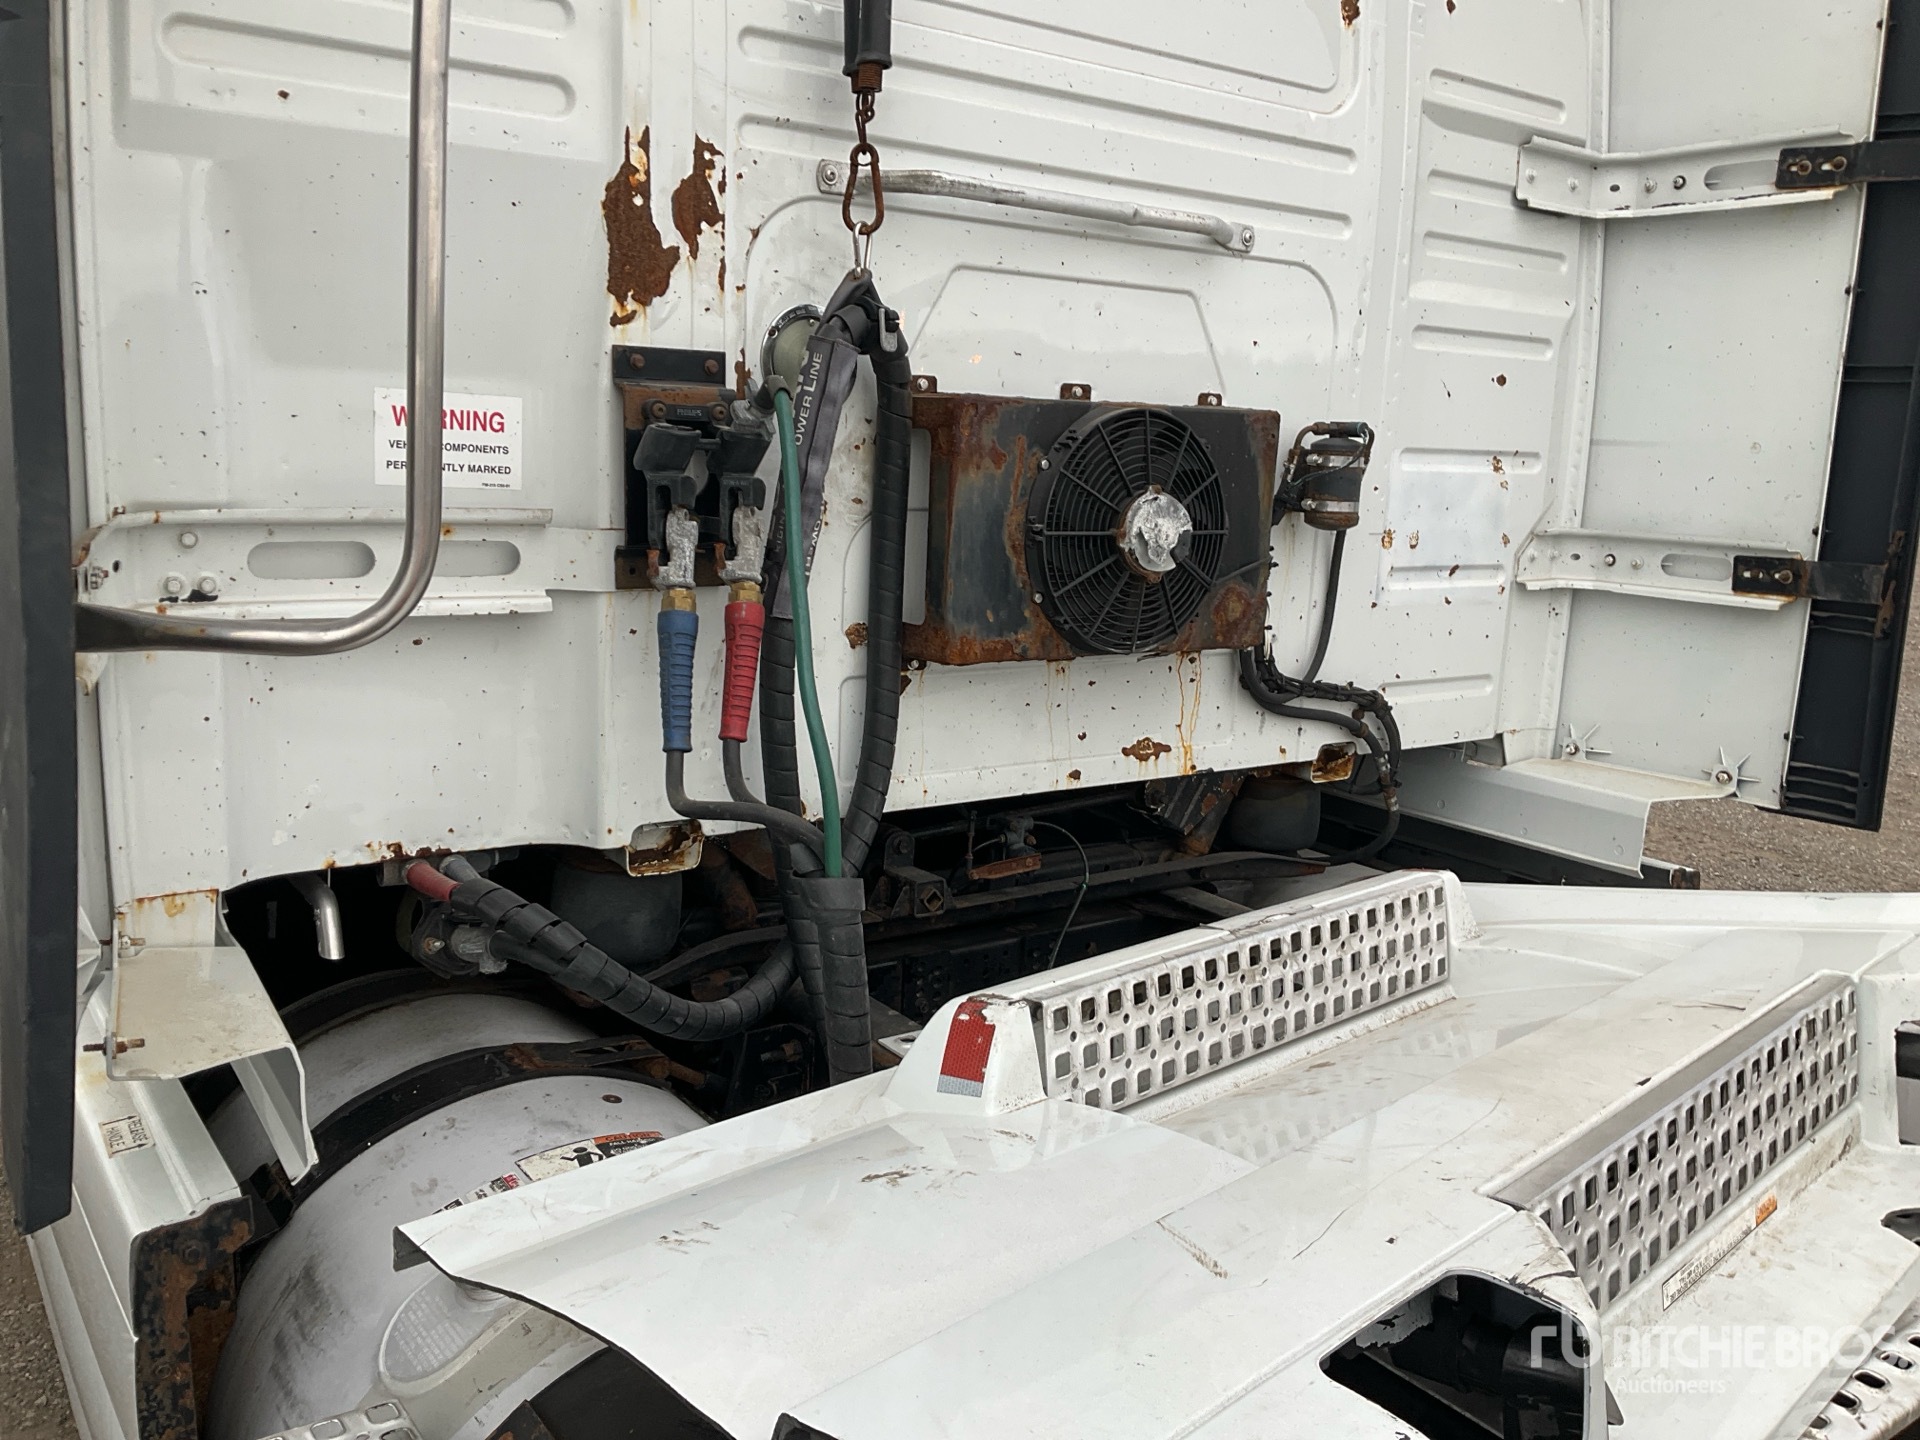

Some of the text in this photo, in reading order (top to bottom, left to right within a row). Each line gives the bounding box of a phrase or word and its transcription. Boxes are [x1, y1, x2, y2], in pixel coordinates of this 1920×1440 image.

[803, 352, 823, 393] LINE
[795, 395, 813, 446] OWER
[442, 443, 510, 455] OMPONENTS
[467, 464, 512, 475] MARKED
